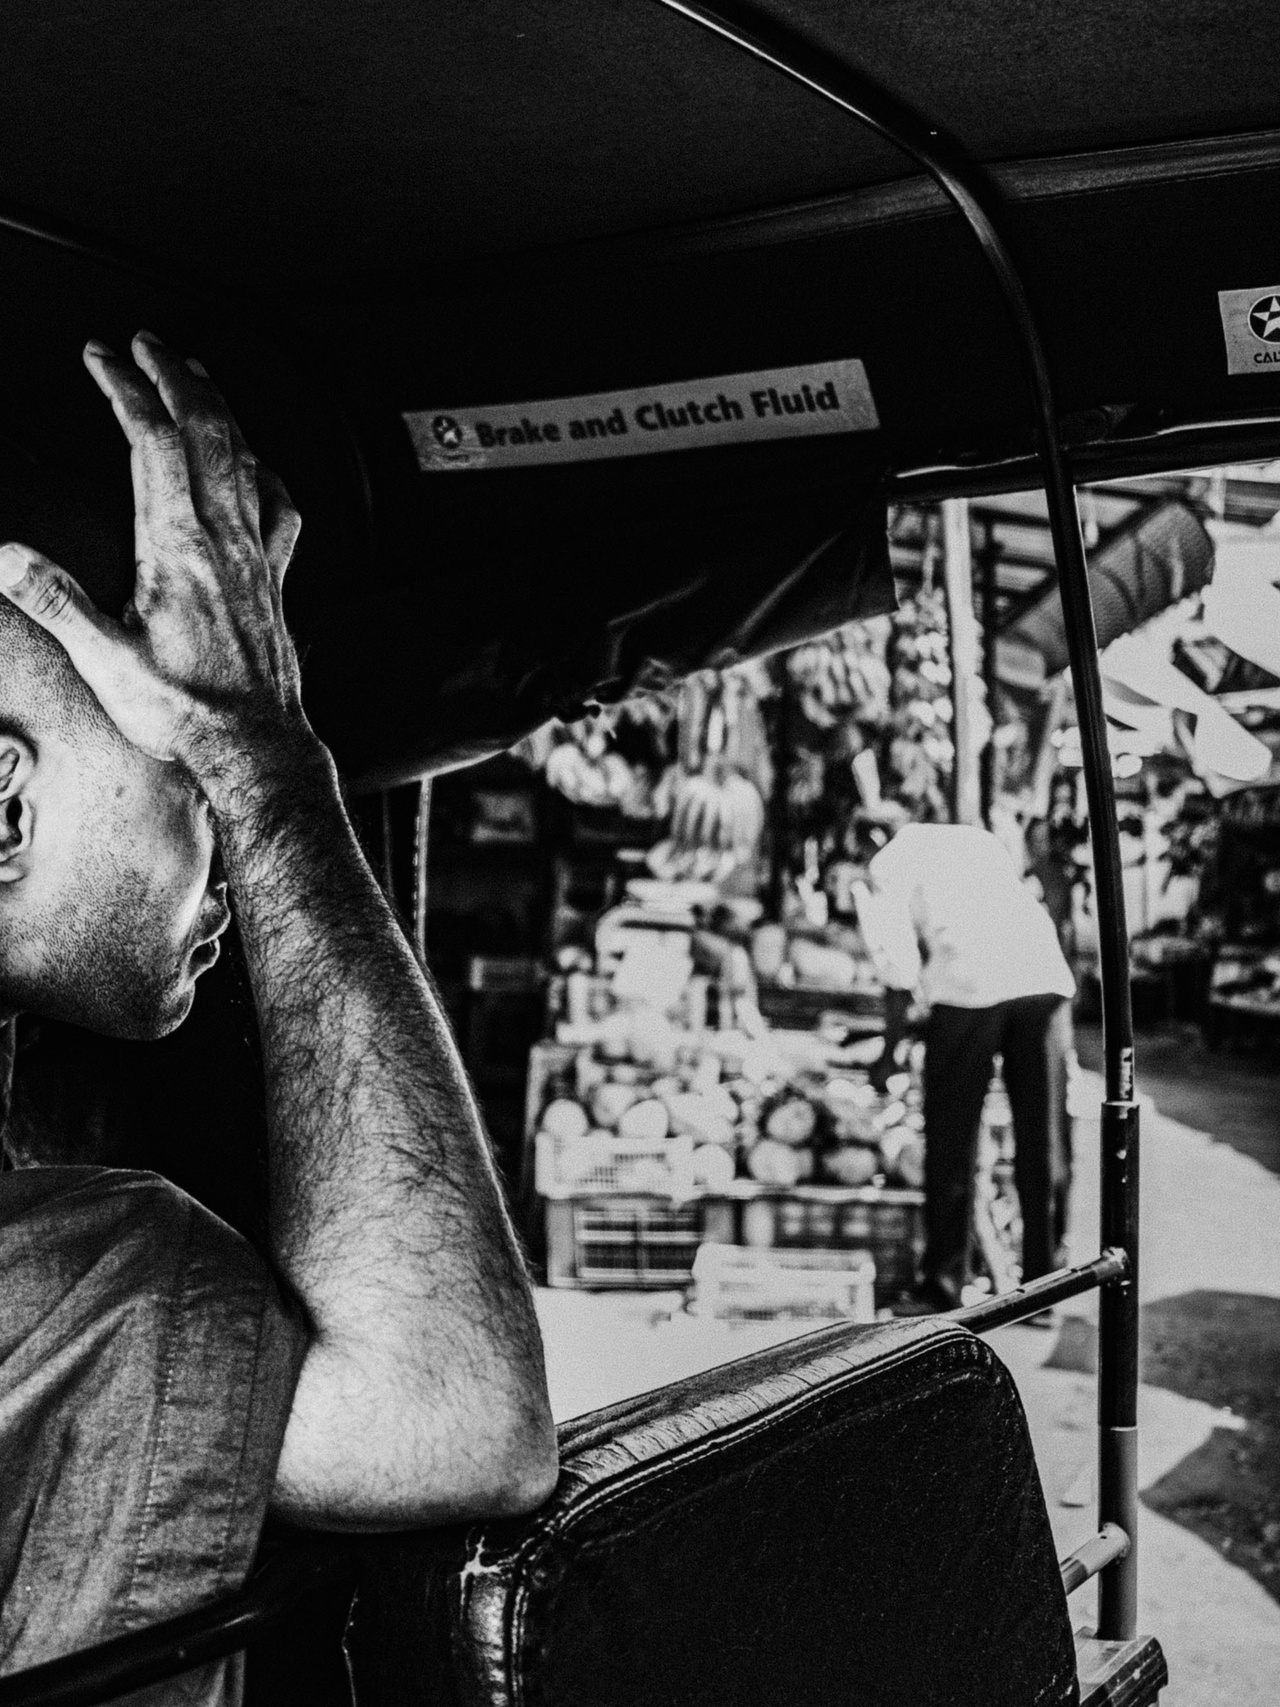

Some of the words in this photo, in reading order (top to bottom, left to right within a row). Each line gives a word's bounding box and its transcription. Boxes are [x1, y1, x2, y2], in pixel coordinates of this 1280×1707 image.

[1253, 351, 1280, 364] CAL
[474, 417, 561, 449] Brake
[569, 408, 628, 440] and
[634, 394, 744, 431] Clutch
[750, 381, 840, 418] Fluid
